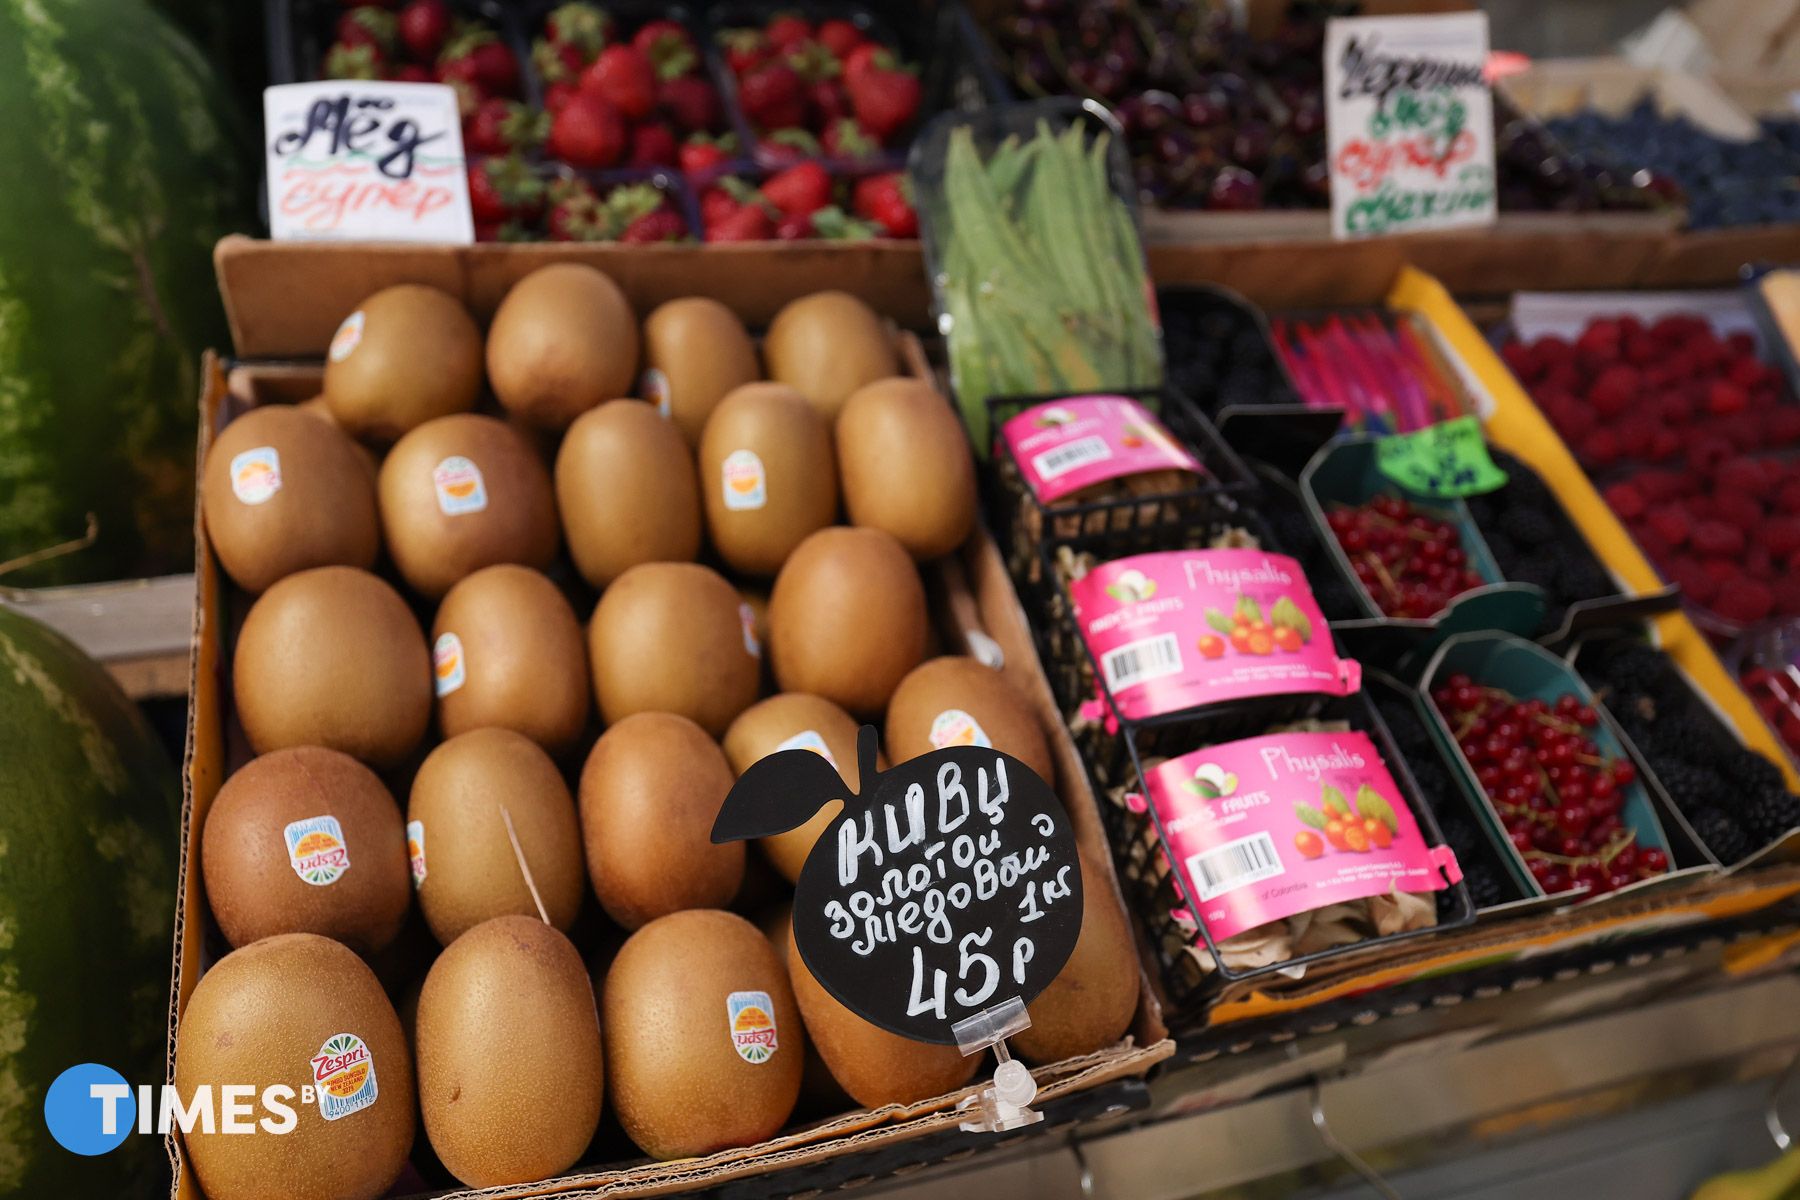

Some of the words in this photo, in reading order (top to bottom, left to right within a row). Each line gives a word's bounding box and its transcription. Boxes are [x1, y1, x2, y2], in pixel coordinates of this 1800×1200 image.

[1260, 743, 1365, 781] Physalis
[906, 927, 1000, 1020] 45
[312, 1045, 367, 1081] Zespri
